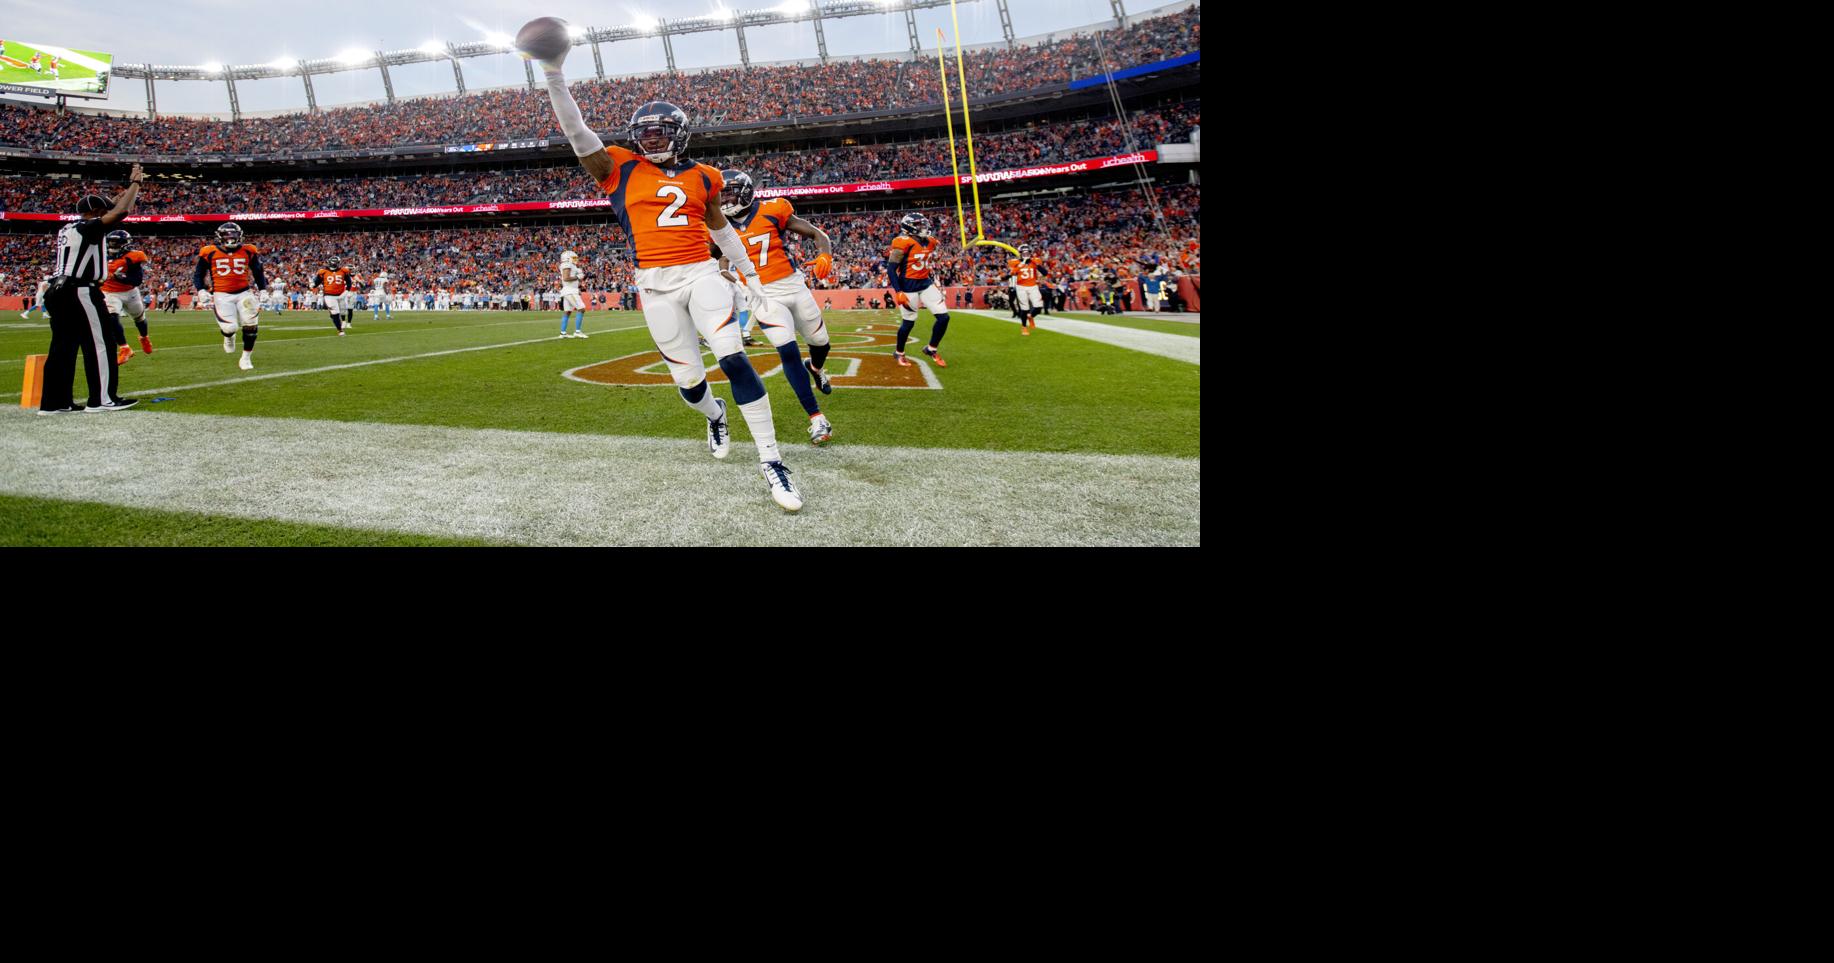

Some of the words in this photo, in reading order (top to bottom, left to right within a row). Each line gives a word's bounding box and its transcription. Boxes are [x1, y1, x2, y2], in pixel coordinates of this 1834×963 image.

[25, 87, 50, 95] FIELD
[1102, 152, 1146, 167] uchealth
[1070, 163, 1087, 171] Out
[857, 182, 891, 192] uchealth
[656, 185, 689, 227] 2
[215, 258, 247, 276] 55
[326, 274, 343, 285] 95
[1020, 267, 1035, 280] 31
